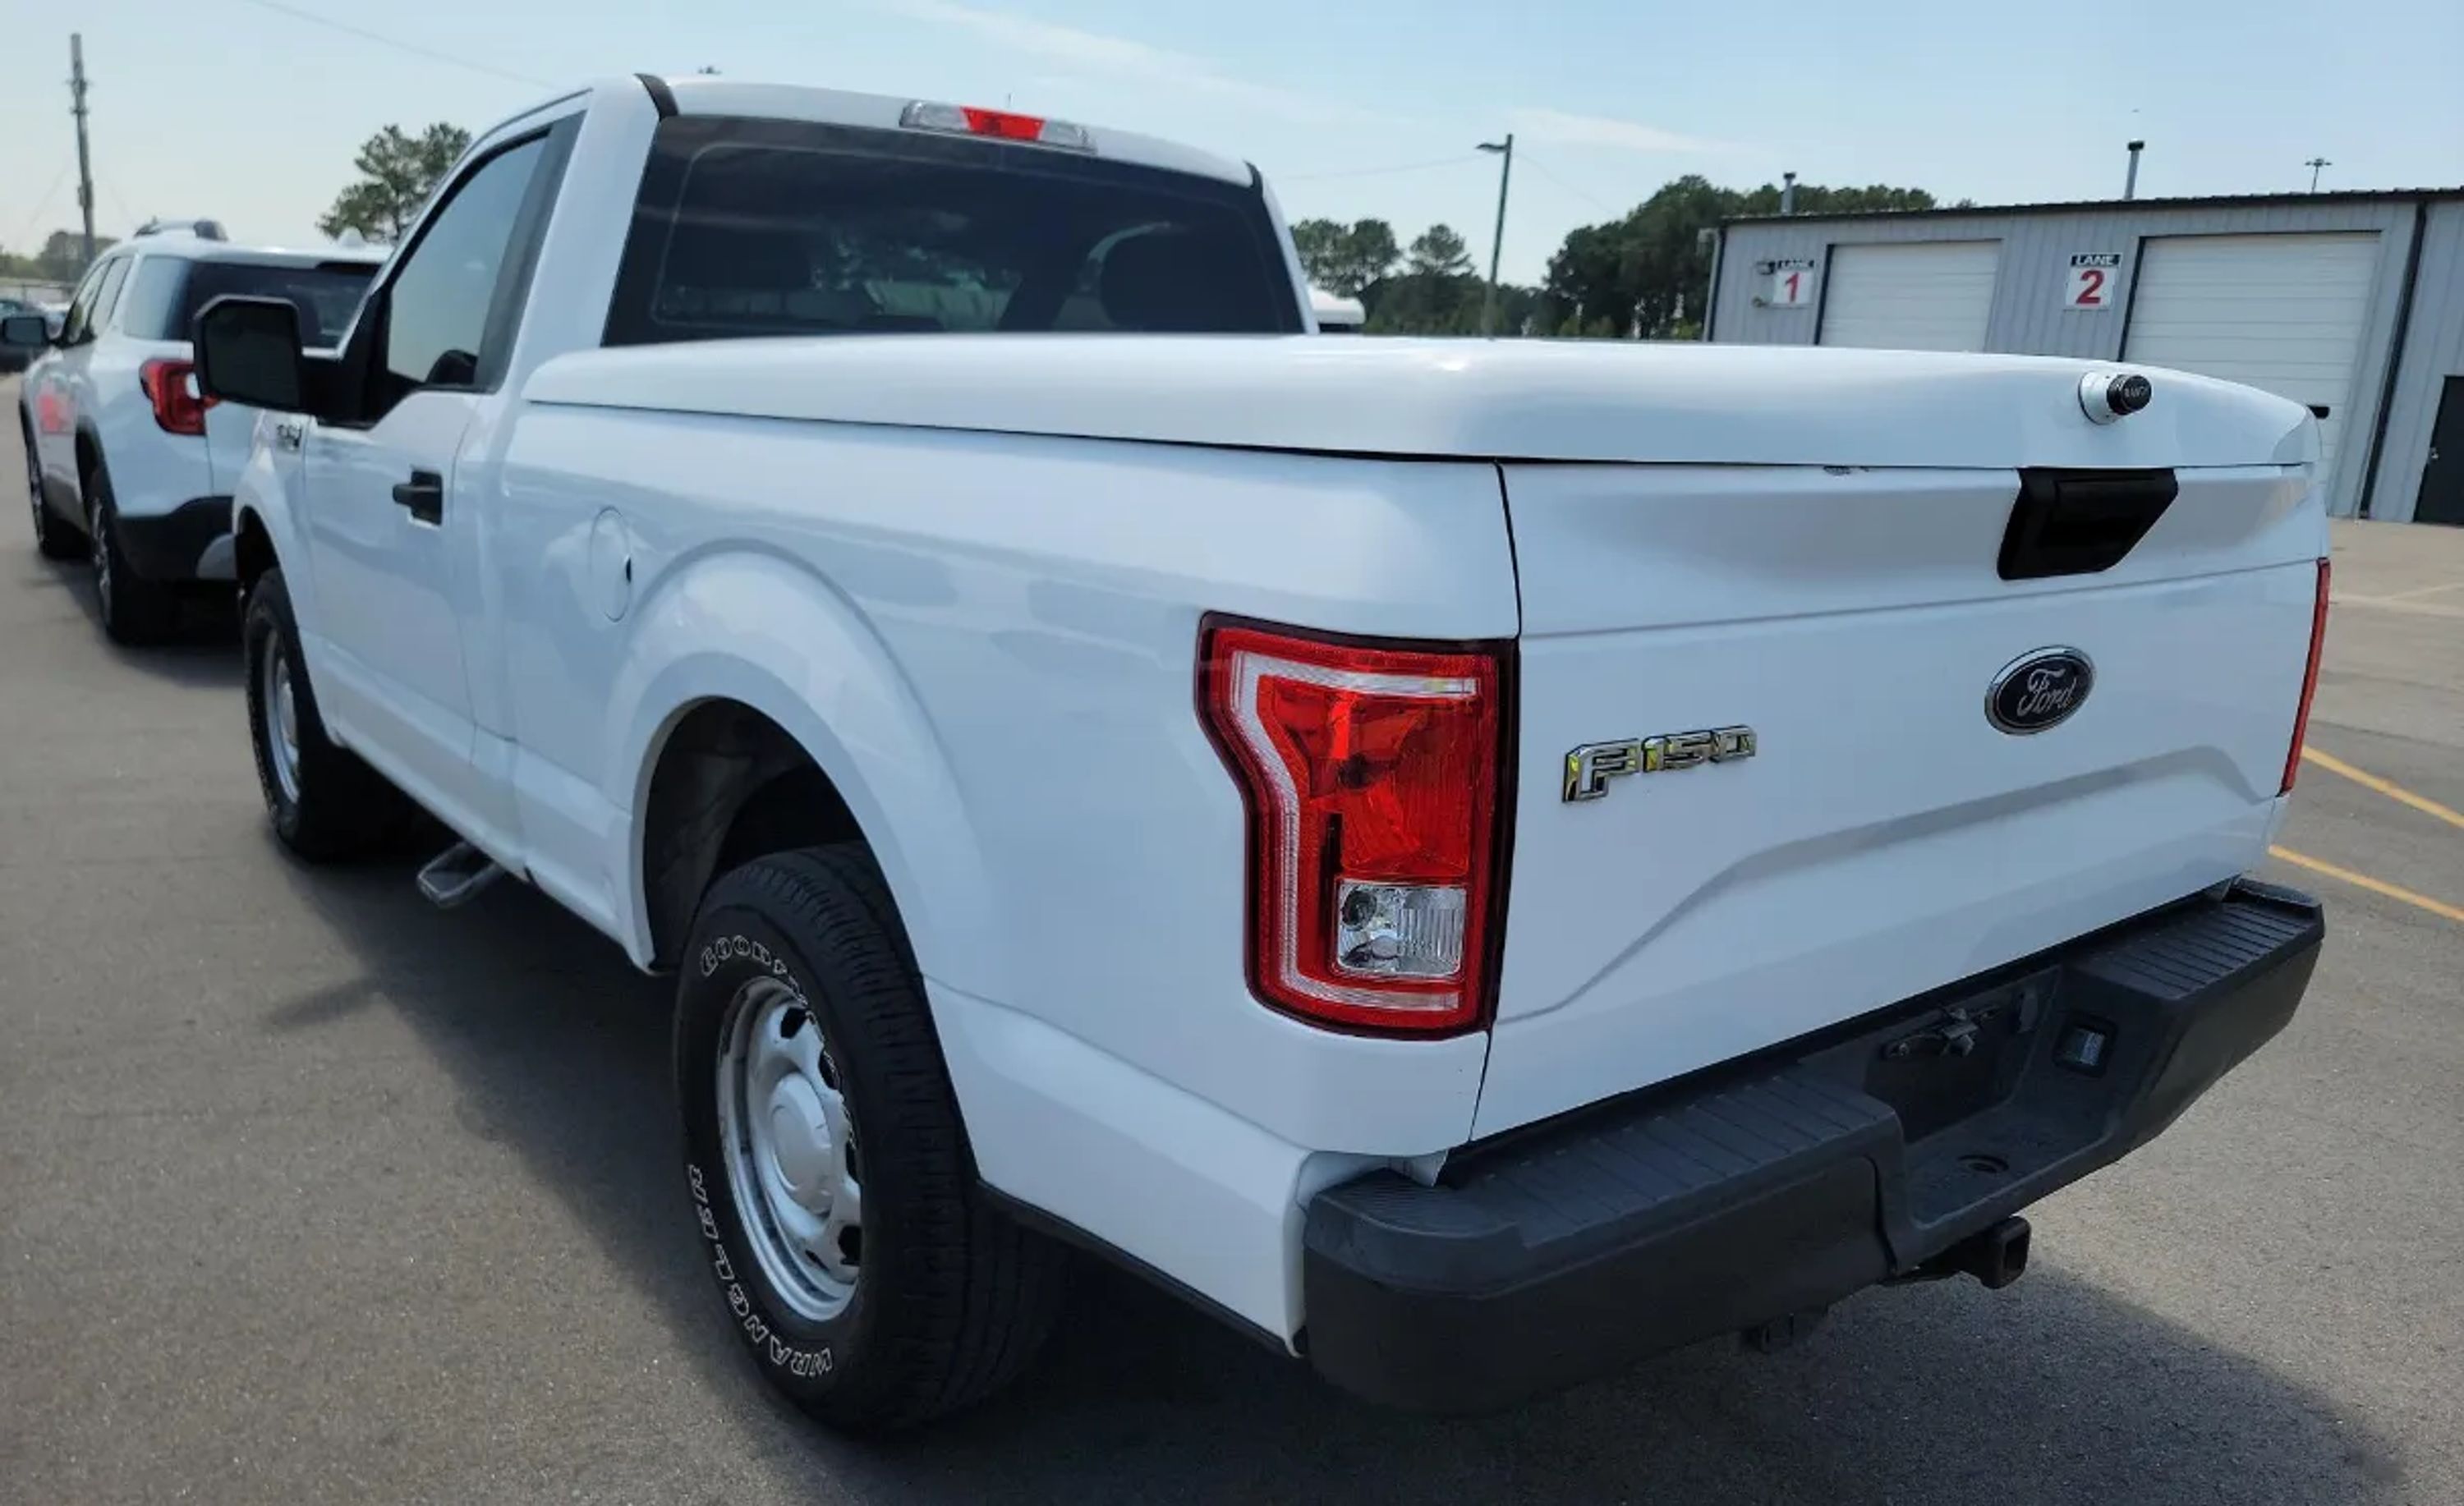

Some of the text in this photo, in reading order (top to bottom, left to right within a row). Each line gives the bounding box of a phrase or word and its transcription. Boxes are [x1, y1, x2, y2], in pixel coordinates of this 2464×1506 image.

[2076, 255, 2115, 265] LANE
[1785, 272, 1799, 303] 1
[2076, 269, 2104, 305] 2
[2016, 668, 2078, 717] Ford
[687, 1164, 833, 1376] WRANGLER
